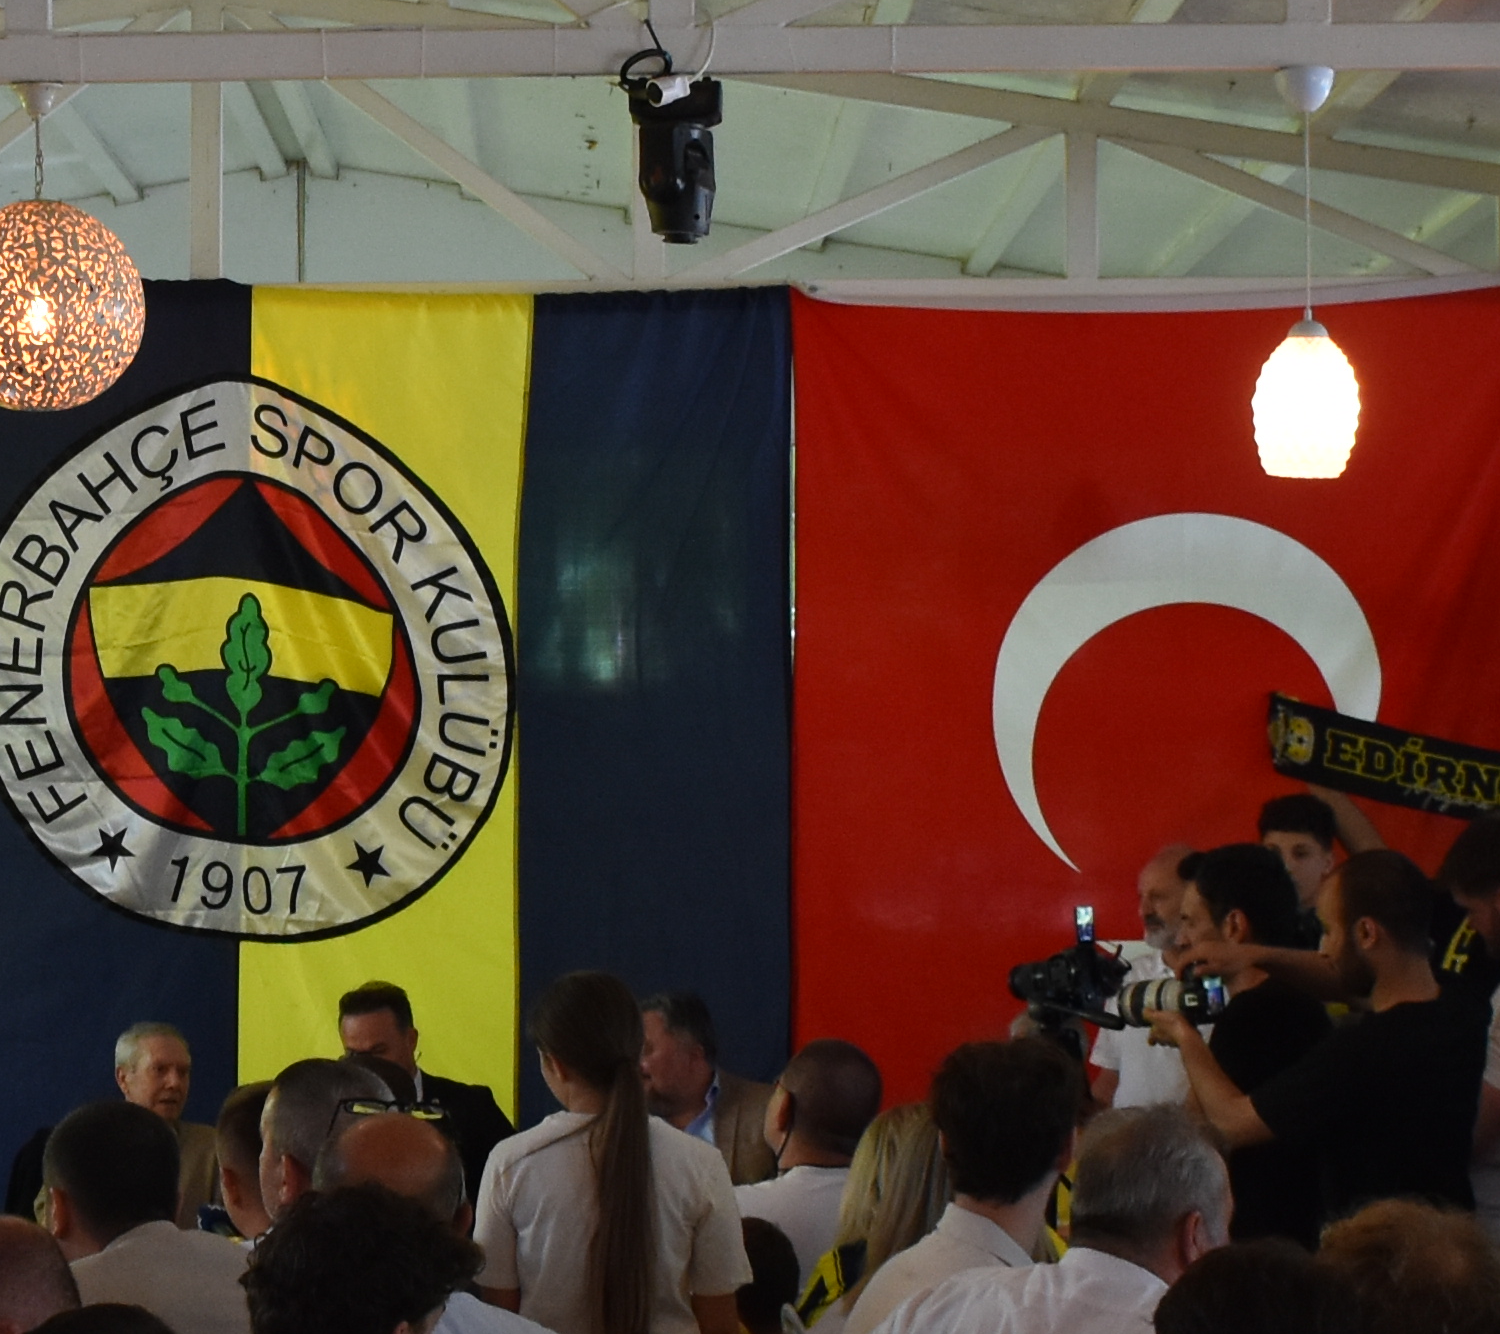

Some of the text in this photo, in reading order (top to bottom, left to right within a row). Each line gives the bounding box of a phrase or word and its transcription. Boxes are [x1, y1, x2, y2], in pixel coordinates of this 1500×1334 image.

[250, 403, 428, 564] SPOR
[398, 566, 500, 852] KULÜBÜ
[169, 855, 307, 915] 1907
